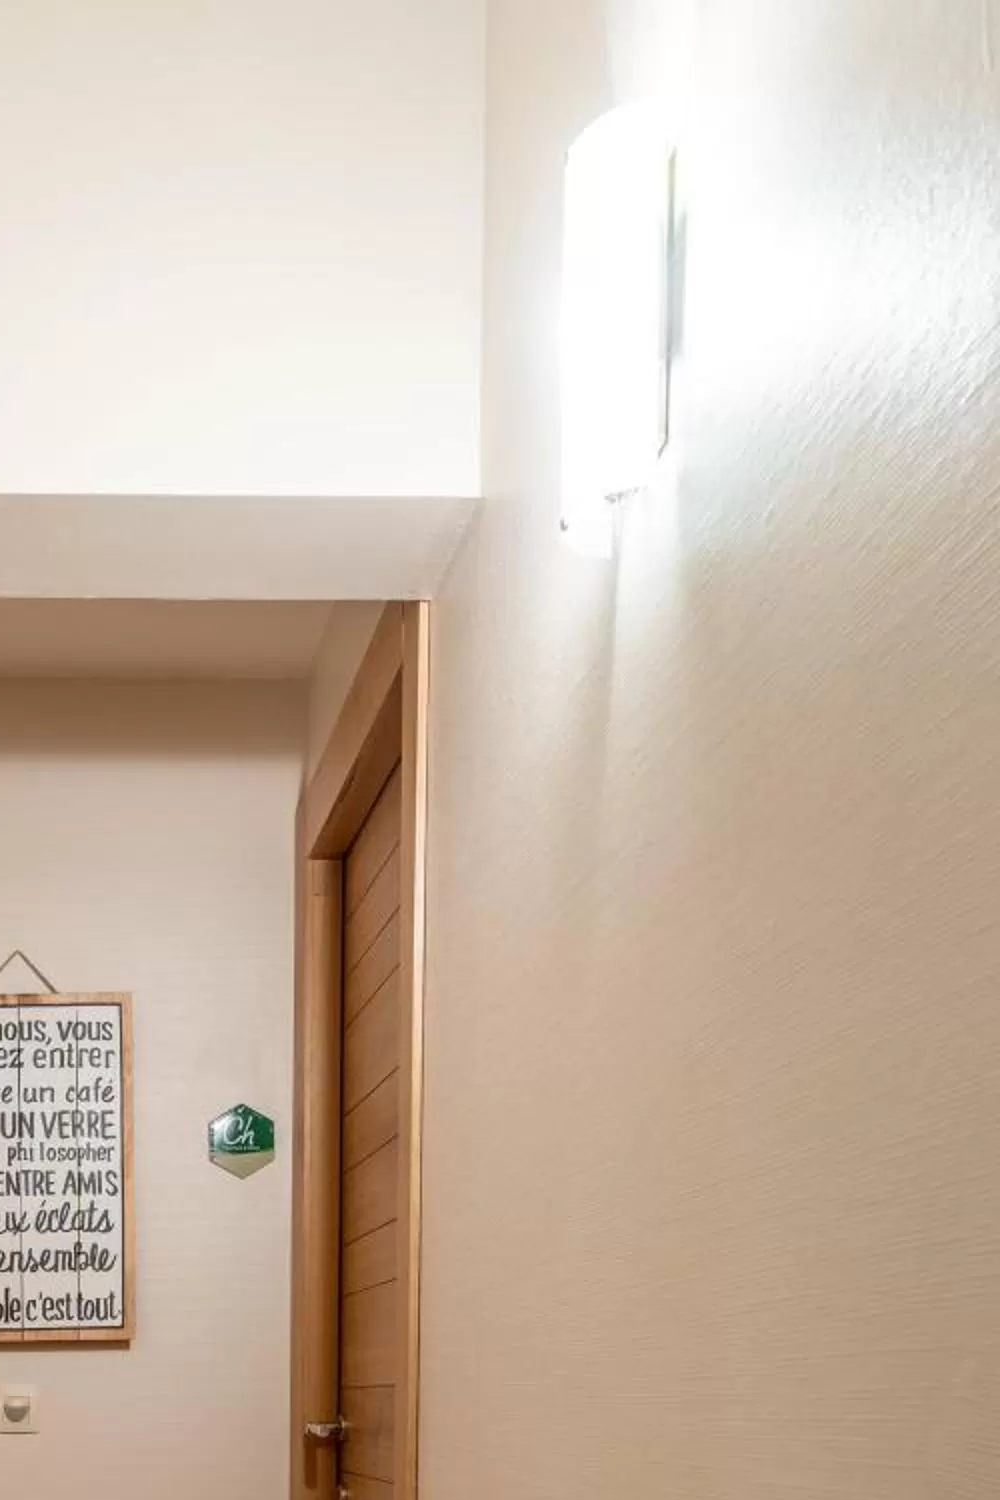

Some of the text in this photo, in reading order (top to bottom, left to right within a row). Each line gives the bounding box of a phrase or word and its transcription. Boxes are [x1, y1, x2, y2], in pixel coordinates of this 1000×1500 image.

[56, 1019, 113, 1042] vous
[32, 1044, 115, 1069] entrer
[22, 1084, 54, 1103] un
[65, 1077, 115, 1103] café
[0, 1111, 35, 1139] UN
[41, 1110, 116, 1139] VERRE
[62, 1170, 119, 1196] AMIS
[35, 1199, 115, 1233] éclats
[26, 1292, 75, 1321] c'est
